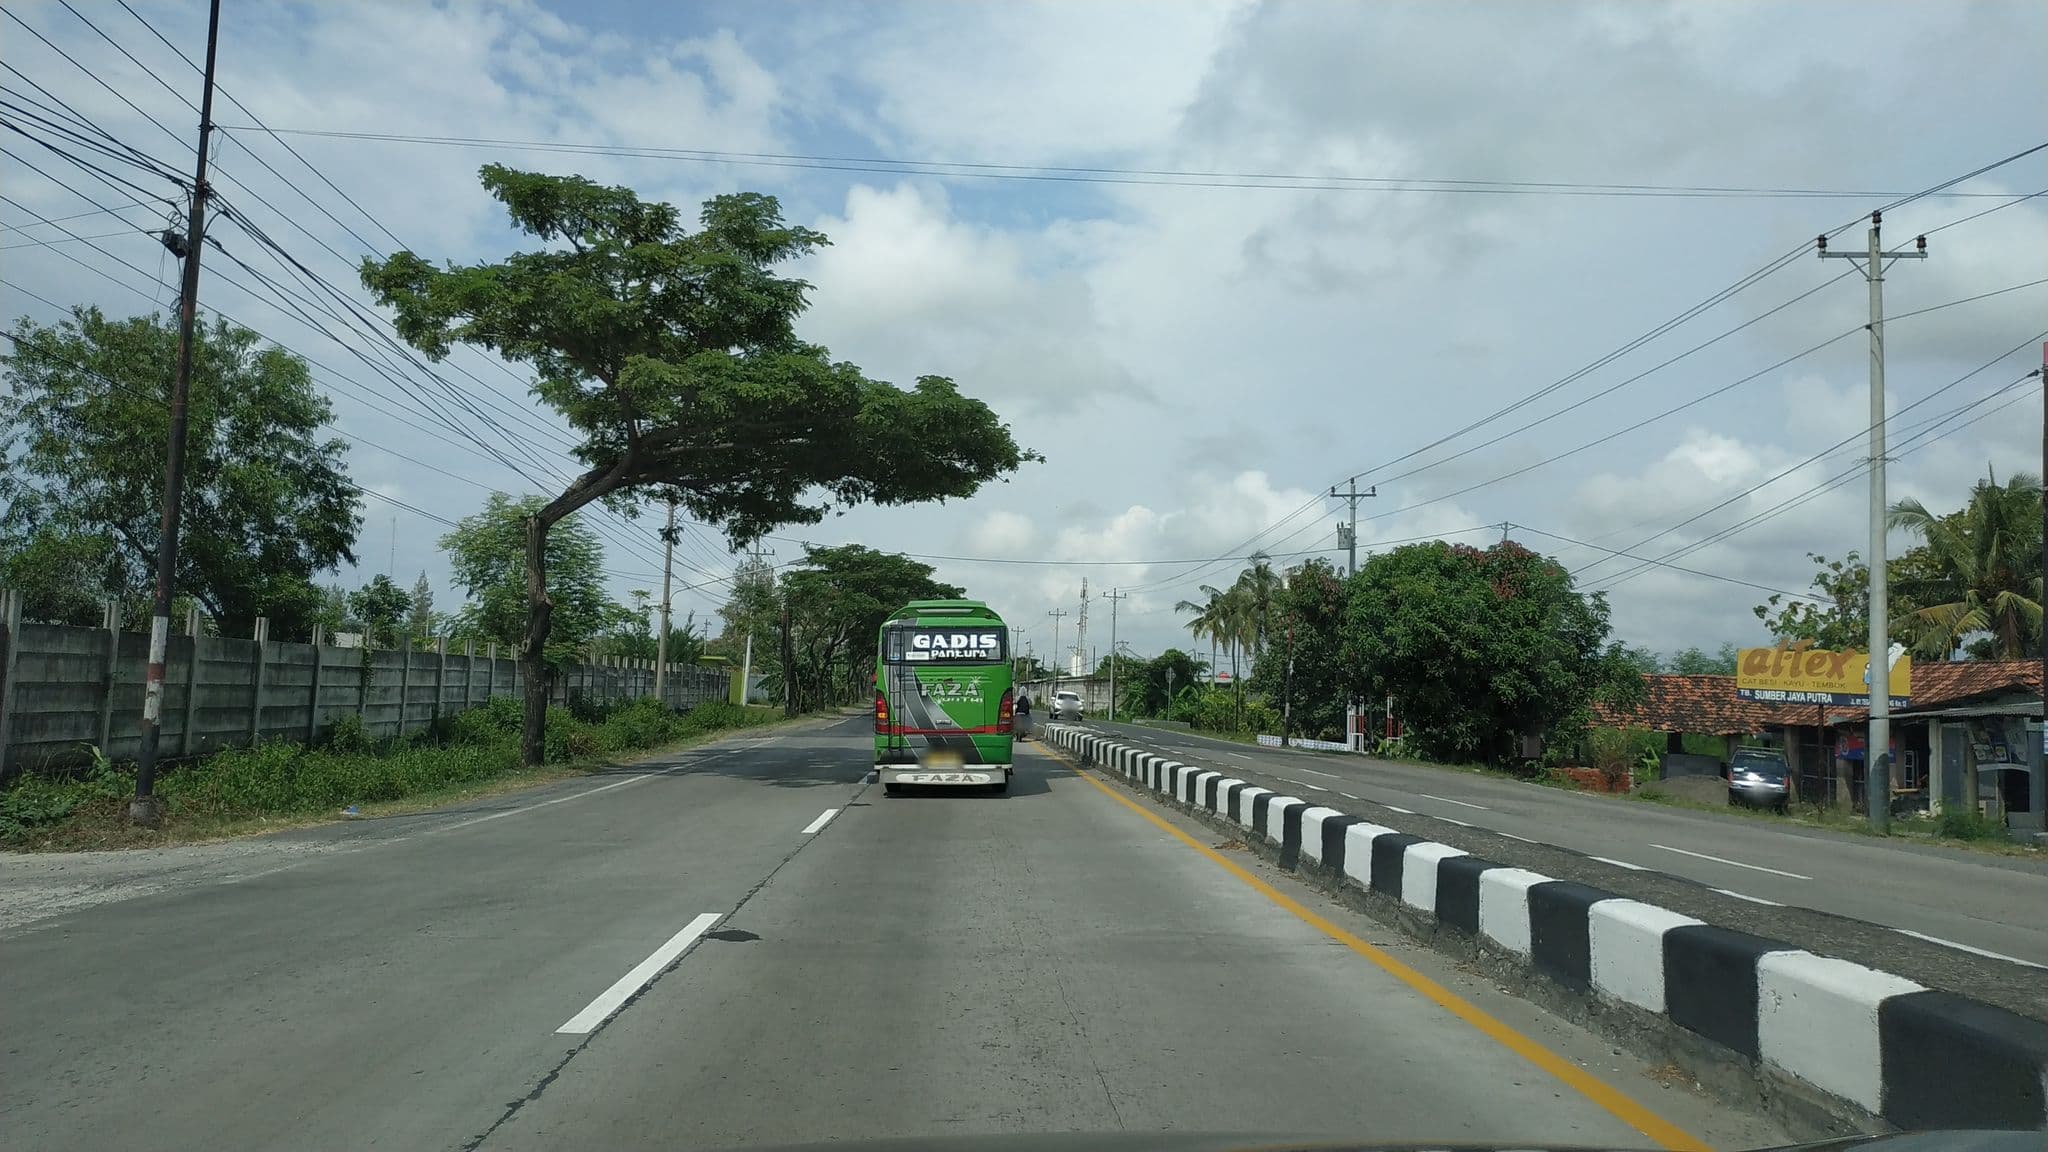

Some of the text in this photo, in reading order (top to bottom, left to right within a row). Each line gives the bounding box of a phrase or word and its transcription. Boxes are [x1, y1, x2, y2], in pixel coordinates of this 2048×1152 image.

[913, 634, 997, 649] GADIS
[921, 683, 979, 697] FAZA
[1759, 678, 1777, 686] BESI
[1783, 680, 1805, 688] KAYU
[1811, 681, 1847, 690] TEMBOK
[1755, 690, 1786, 701] SUMBER
[1787, 691, 1806, 702] JAYA
[1807, 692, 1833, 704] PUTRA
[911, 774, 976, 782] FAZA
